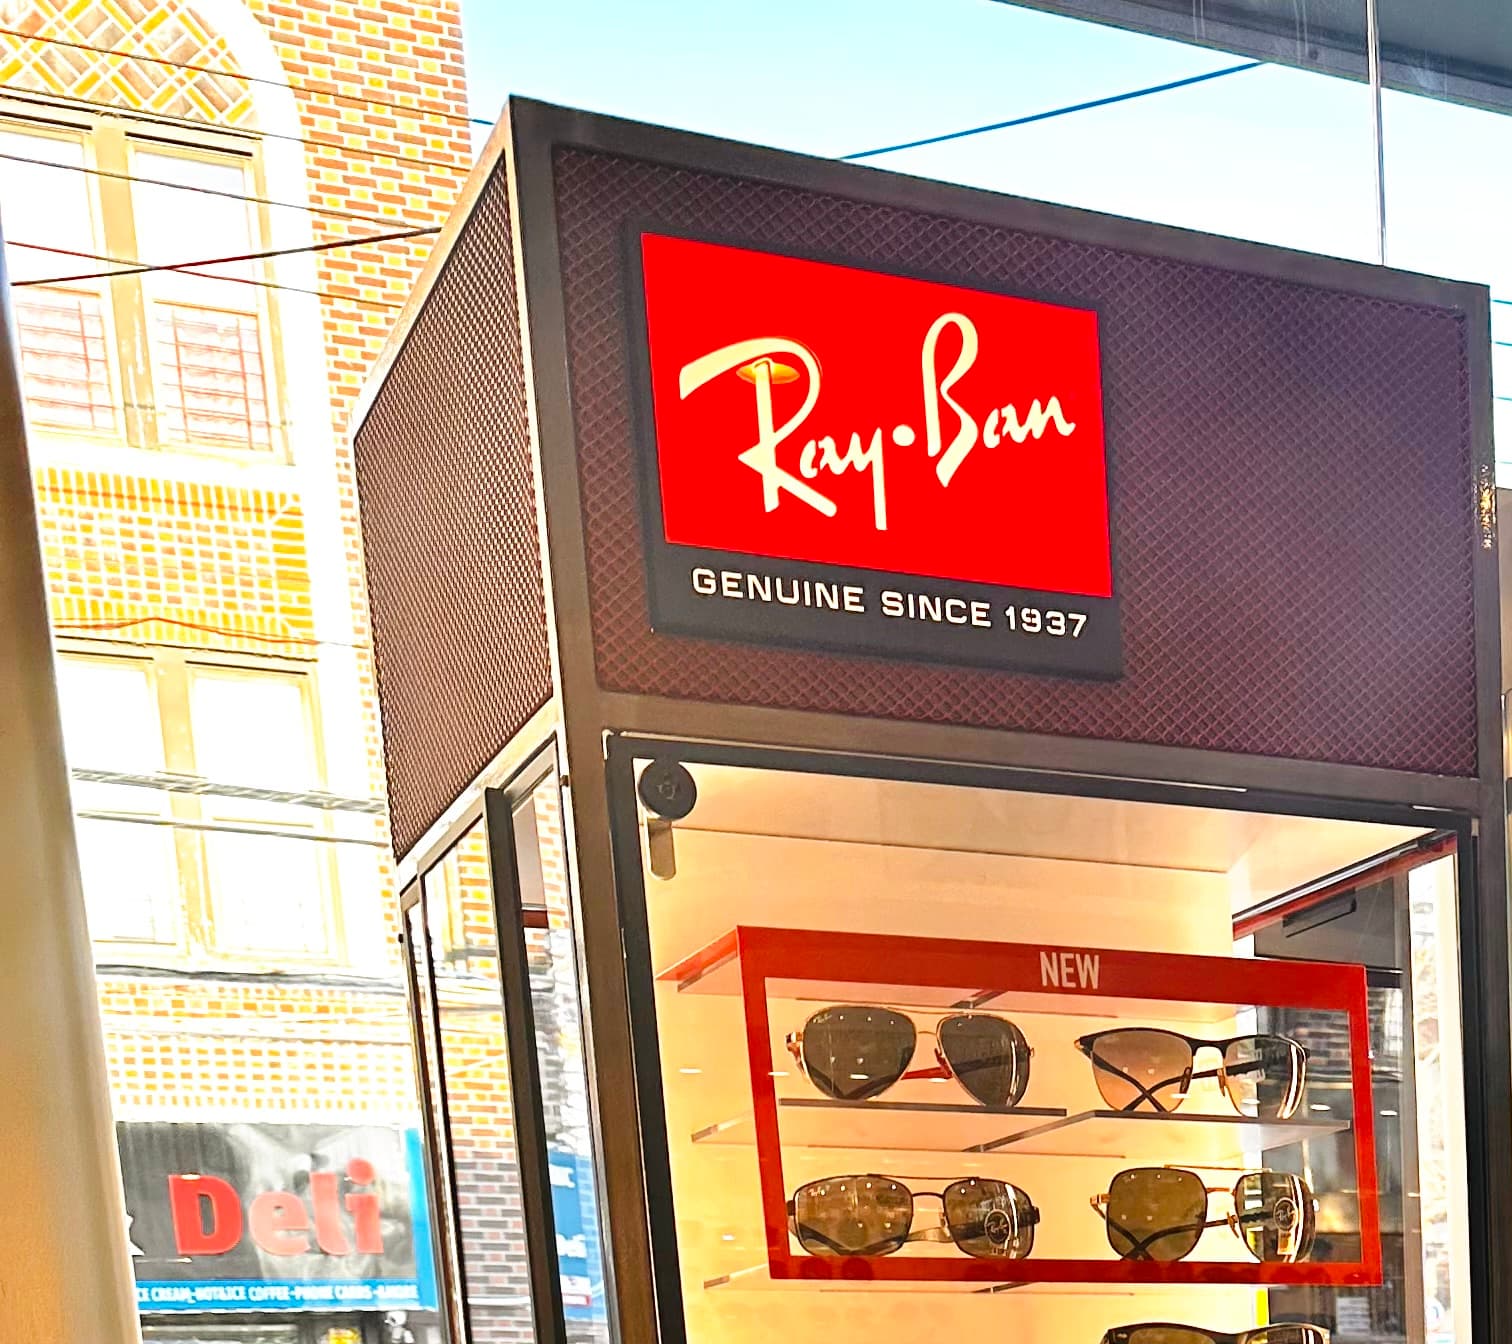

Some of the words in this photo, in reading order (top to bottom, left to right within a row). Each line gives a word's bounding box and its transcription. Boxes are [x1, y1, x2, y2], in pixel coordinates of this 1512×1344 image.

[691, 567, 866, 614] GENUINE
[881, 590, 993, 629] SINCE
[1004, 605, 1089, 639] 1937
[1039, 951, 1100, 991] NEW
[168, 1157, 386, 1257] Deli
